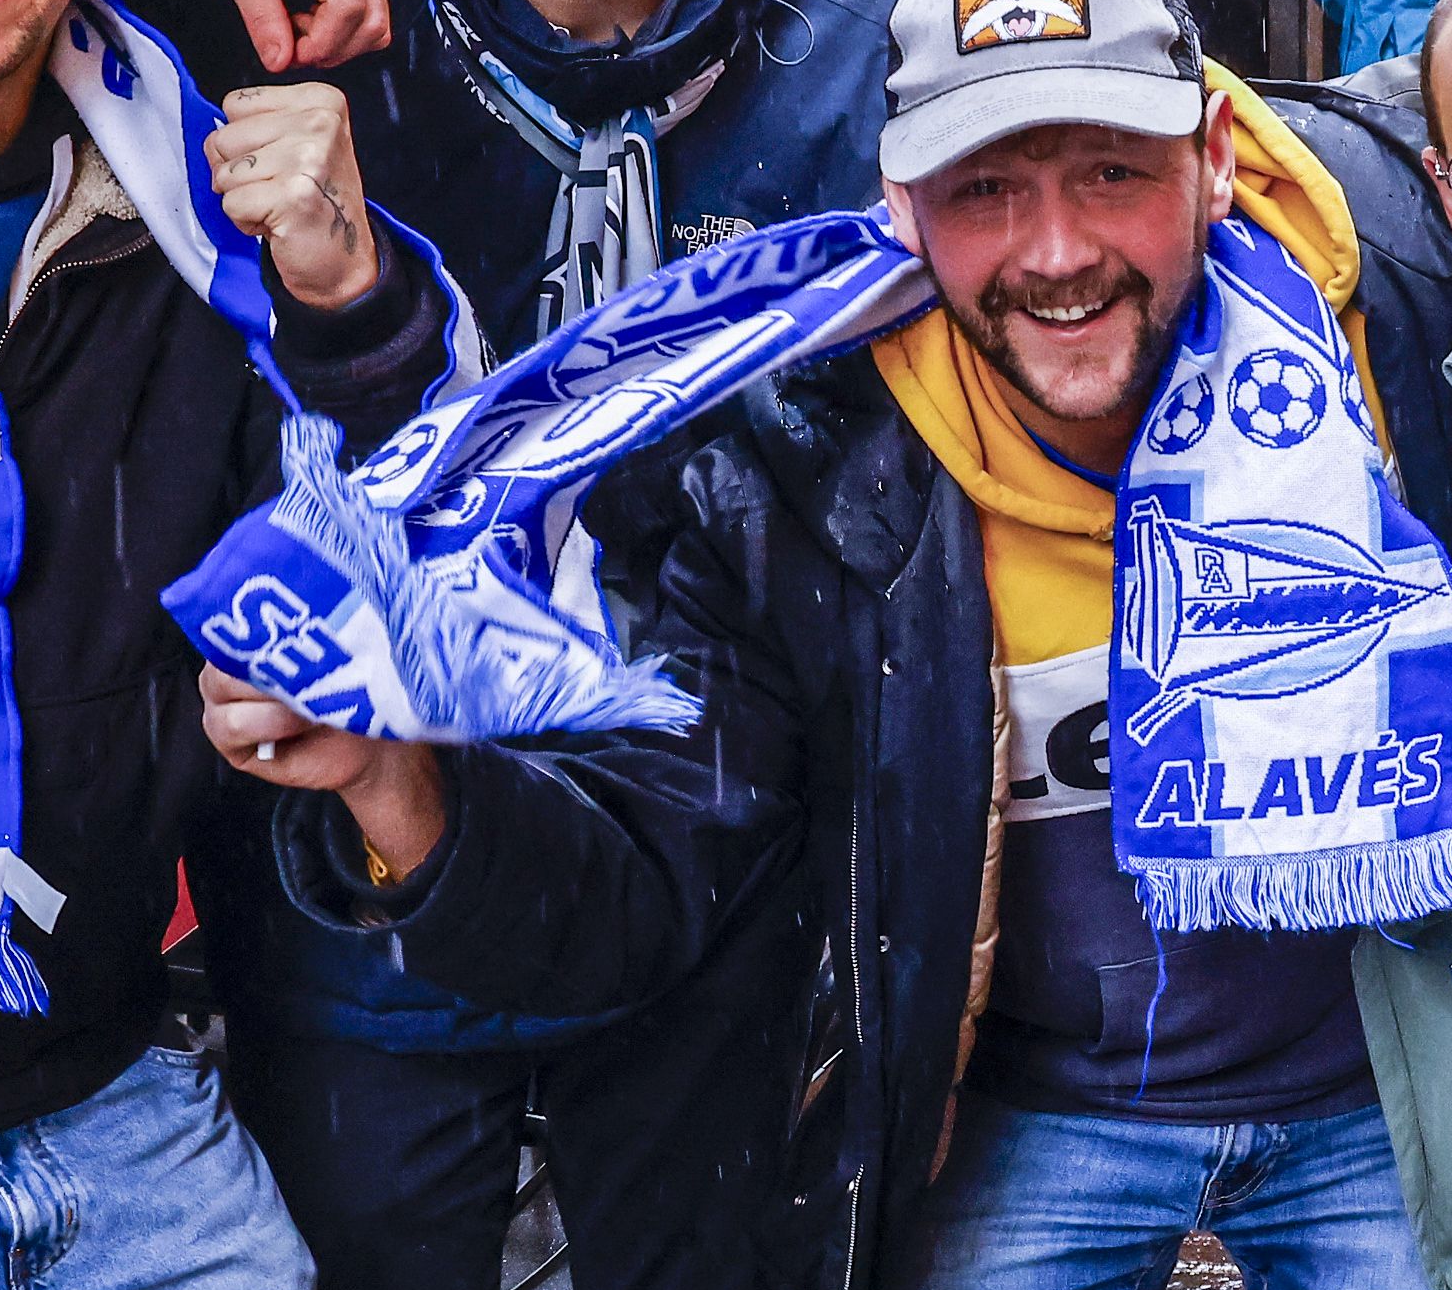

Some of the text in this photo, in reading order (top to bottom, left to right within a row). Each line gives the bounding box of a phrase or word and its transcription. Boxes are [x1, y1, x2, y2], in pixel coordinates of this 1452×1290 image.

[700, 213, 735, 231] THE
[671, 223, 734, 244] NORTH
[1135, 732, 1443, 830] ALAVÉS
